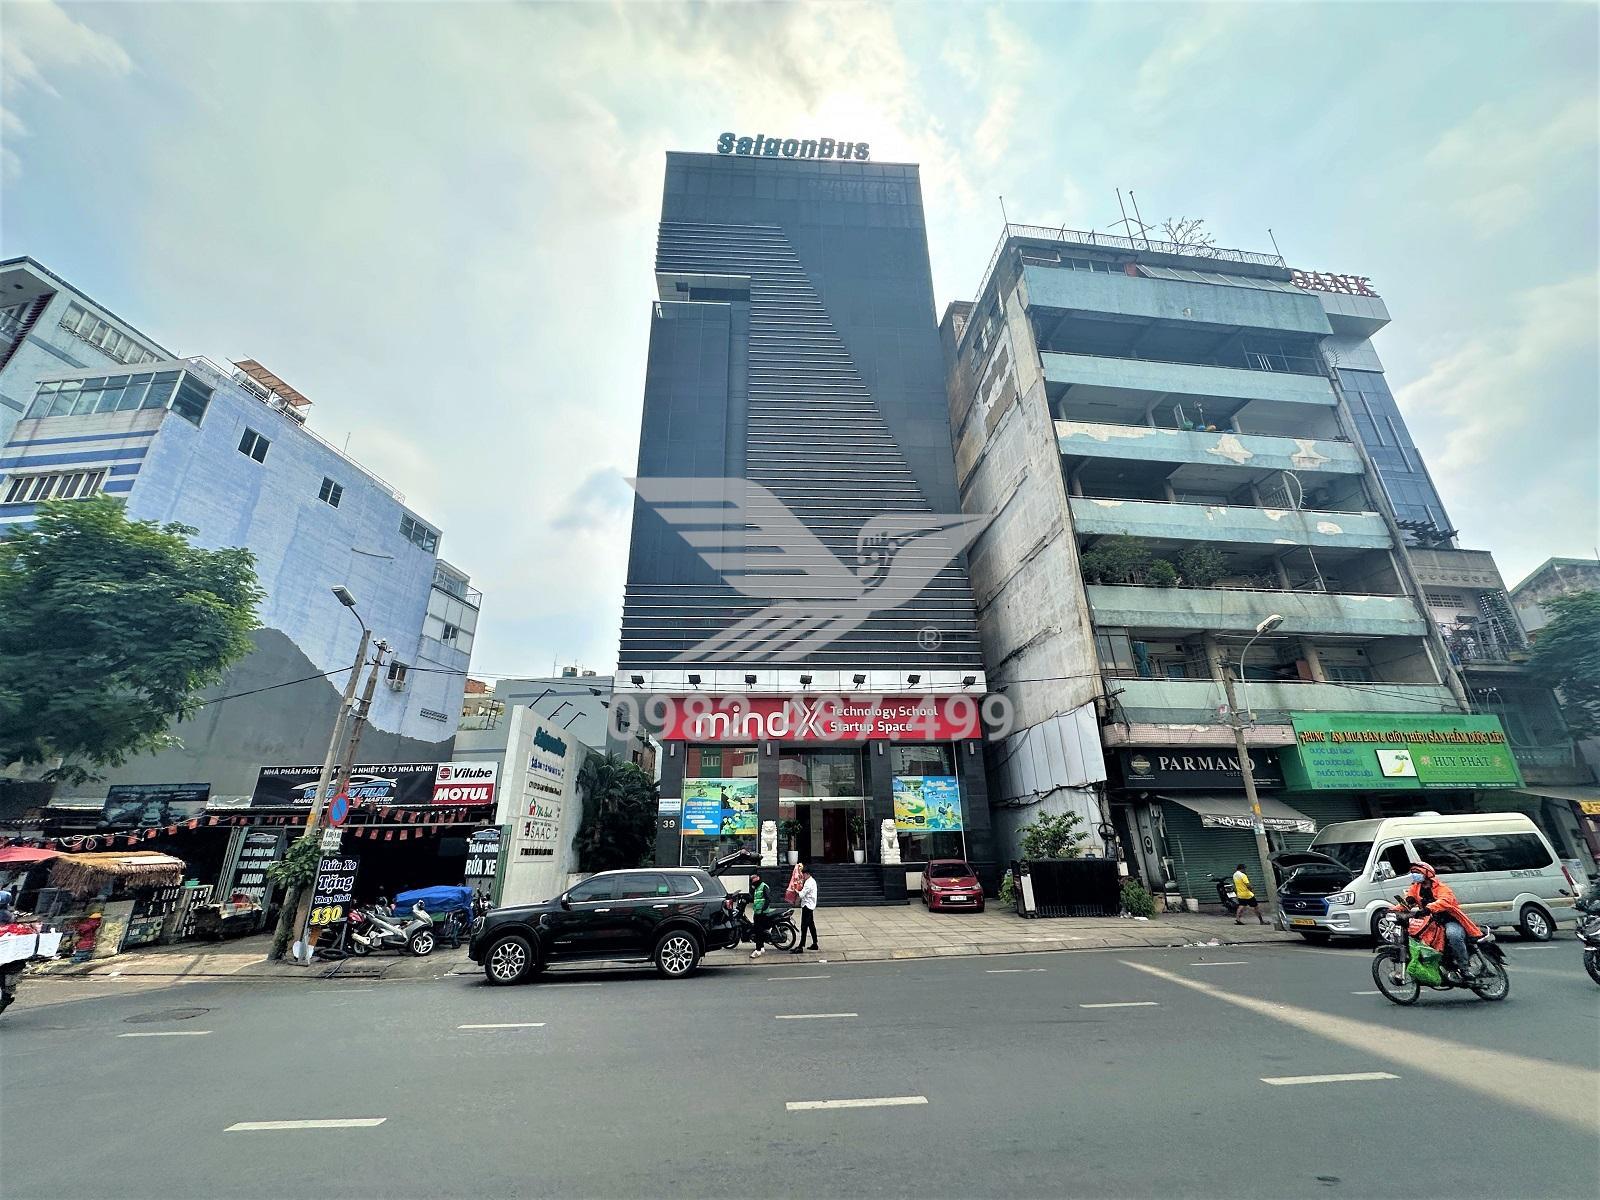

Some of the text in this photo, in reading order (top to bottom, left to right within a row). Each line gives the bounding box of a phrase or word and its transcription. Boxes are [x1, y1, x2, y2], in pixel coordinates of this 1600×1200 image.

[717, 132, 870, 160] SaigonBus
[830, 705, 939, 719] Technology School
[695, 700, 827, 738] mindX
[830, 721, 913, 735] Startup Space
[1344, 731, 1361, 743] MUA
[1433, 754, 1491, 767] HUY PHÁT
[263, 767, 279, 775] NHÀ
[454, 767, 493, 778] Vilube
[433, 787, 489, 801] MOTUL
[662, 819, 676, 829] 39
[343, 860, 357, 871] Xe
[484, 859, 497, 875] XE
[240, 873, 263, 884] NANO
[318, 874, 354, 894] Tặng
